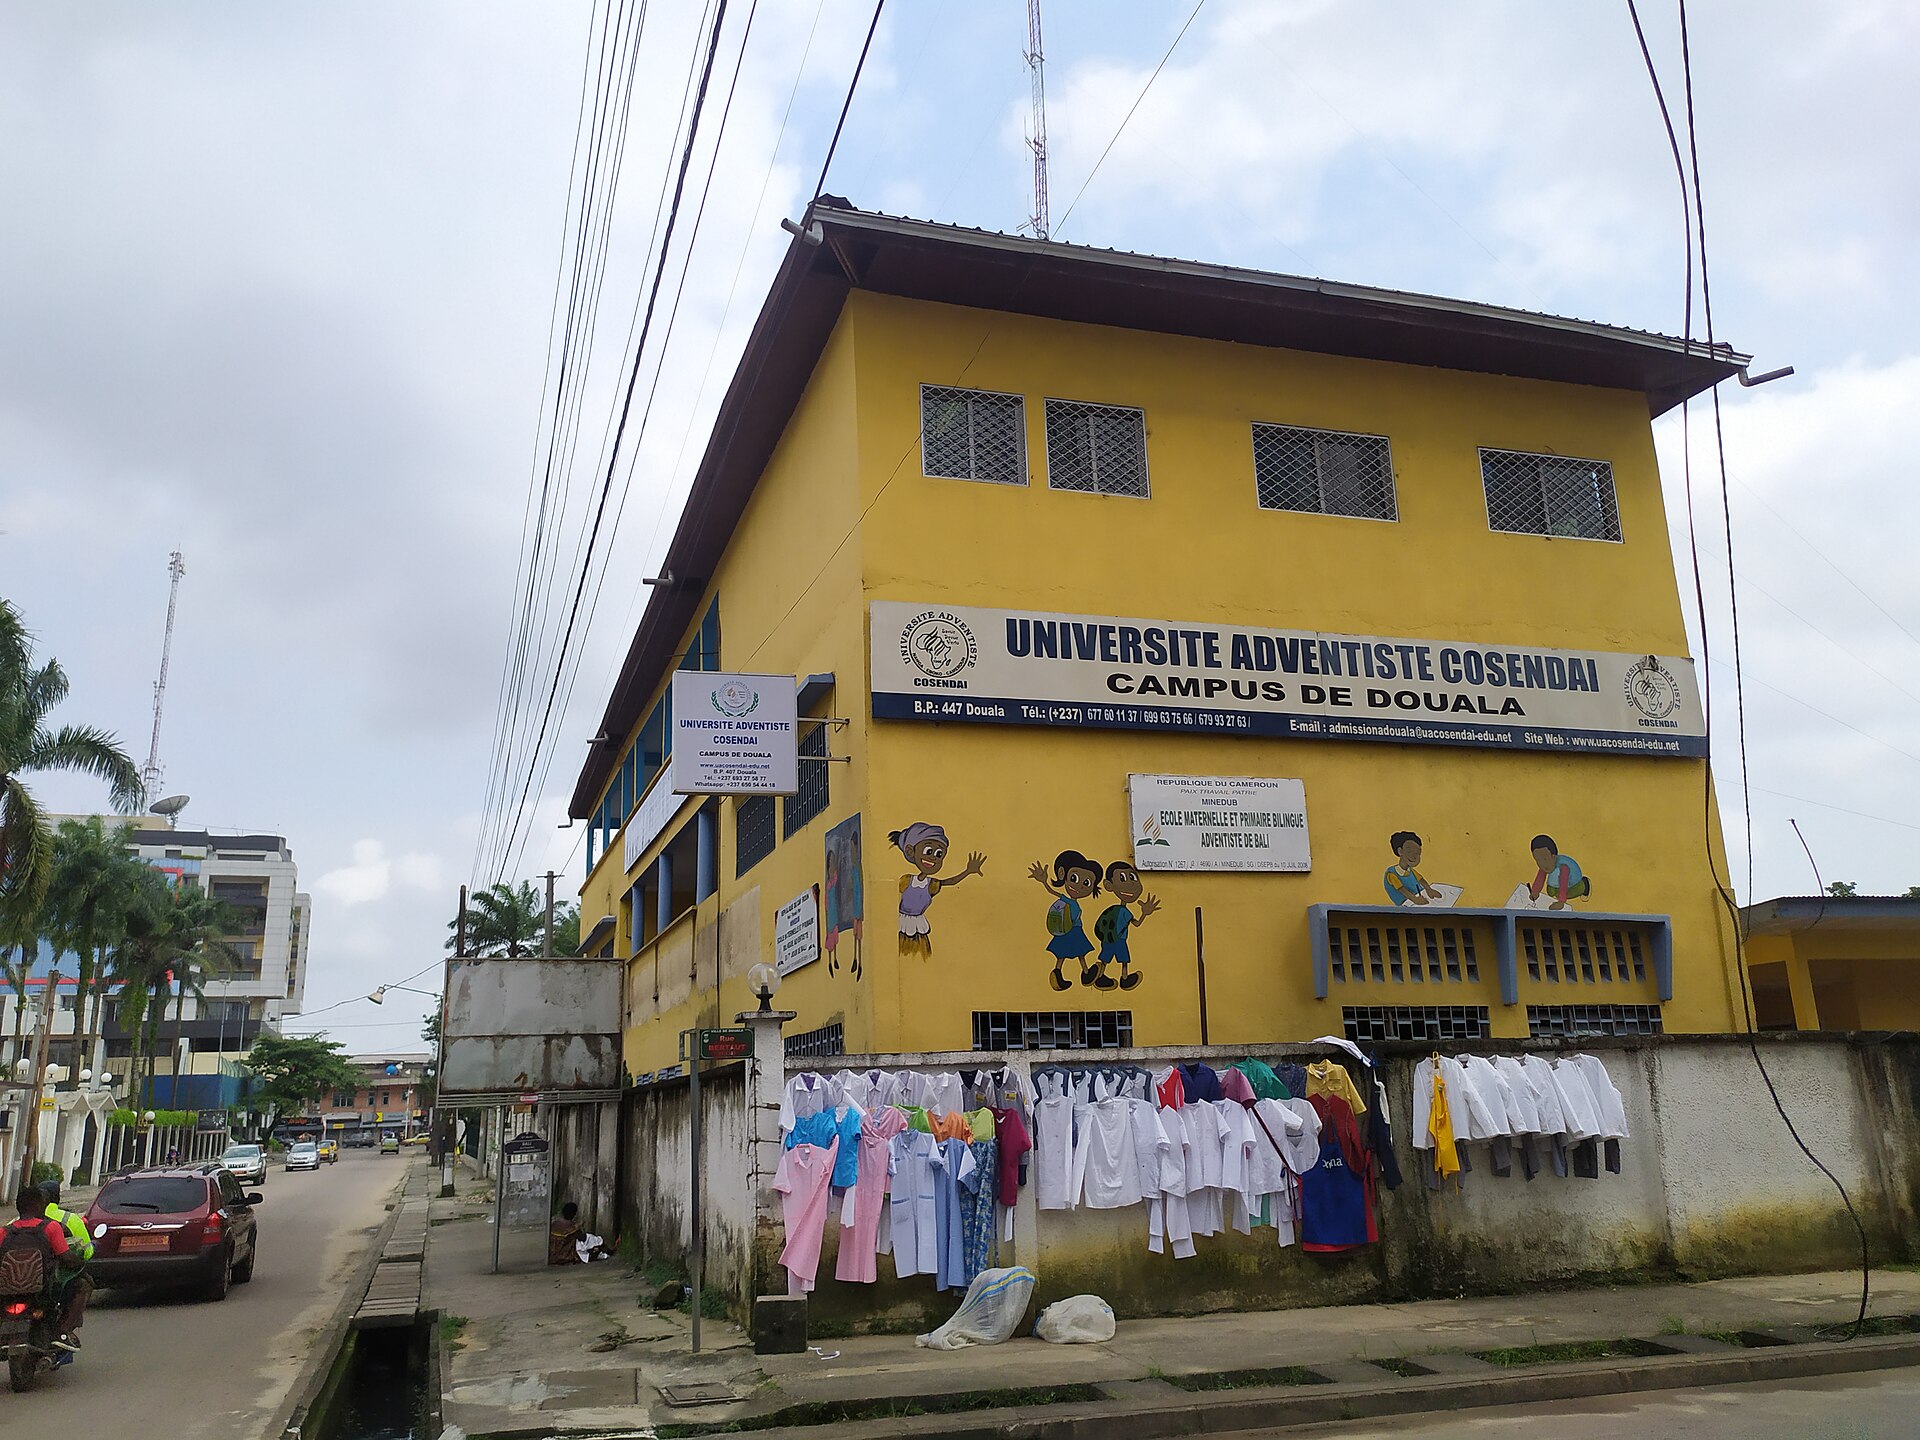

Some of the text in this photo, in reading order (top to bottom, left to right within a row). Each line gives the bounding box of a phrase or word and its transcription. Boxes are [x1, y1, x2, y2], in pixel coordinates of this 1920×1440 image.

[900, 611, 977, 668] UNIVERSITE ADVENTISTE
[1005, 618, 1600, 692] UNIVERSITE ADVENTISTE COSENDAI
[913, 677, 968, 689] COSENDAI
[1106, 673, 1526, 716] CAMPUS DE DOUALA
[680, 719, 790, 731] UNIVERSITE ADVENTISTE
[914, 700, 939, 714] B.P.:
[941, 702, 963, 715] 447
[966, 703, 1005, 717] Douala
[1021, 705, 1046, 719] Tél.:
[1049, 706, 1083, 723] (+237)
[1087, 708, 1102, 721] 677
[1104, 709, 1115, 721] 60
[1115, 710, 1126, 722] 11
[1128, 711, 1138, 723] 37
[1144, 710, 1158, 724] 699
[1160, 711, 1170, 724] 63
[1171, 712, 1182, 725] 75
[1183, 712, 1193, 725] 66
[1198, 713, 1213, 726] 679
[1214, 714, 1225, 727] 93
[1226, 715, 1235, 727] 27
[1236, 715, 1247, 728] 63
[1289, 719, 1321, 733] E-mail
[1328, 722, 1512, 743] admissionadouala@uacosendai-edu.net
[1524, 732, 1543, 744] Site
[1544, 733, 1564, 745] Web
[1571, 737, 1680, 751] www.uacosendai-edu.net
[1638, 718, 1678, 728] COSENDAI
[713, 735, 758, 745] COSENDAI
[1156, 779, 1279, 789] REPUBLIQUE DU CAMEROUN
[1201, 798, 1238, 807] MINEDUB
[1160, 810, 1304, 829] ECOLE MATERNELLE ET PRIMAIRE BILINGUE
[1200, 832, 1270, 849] ADVENTISTE DE BALI
[1221, 860, 1243, 868] MINEDUB
